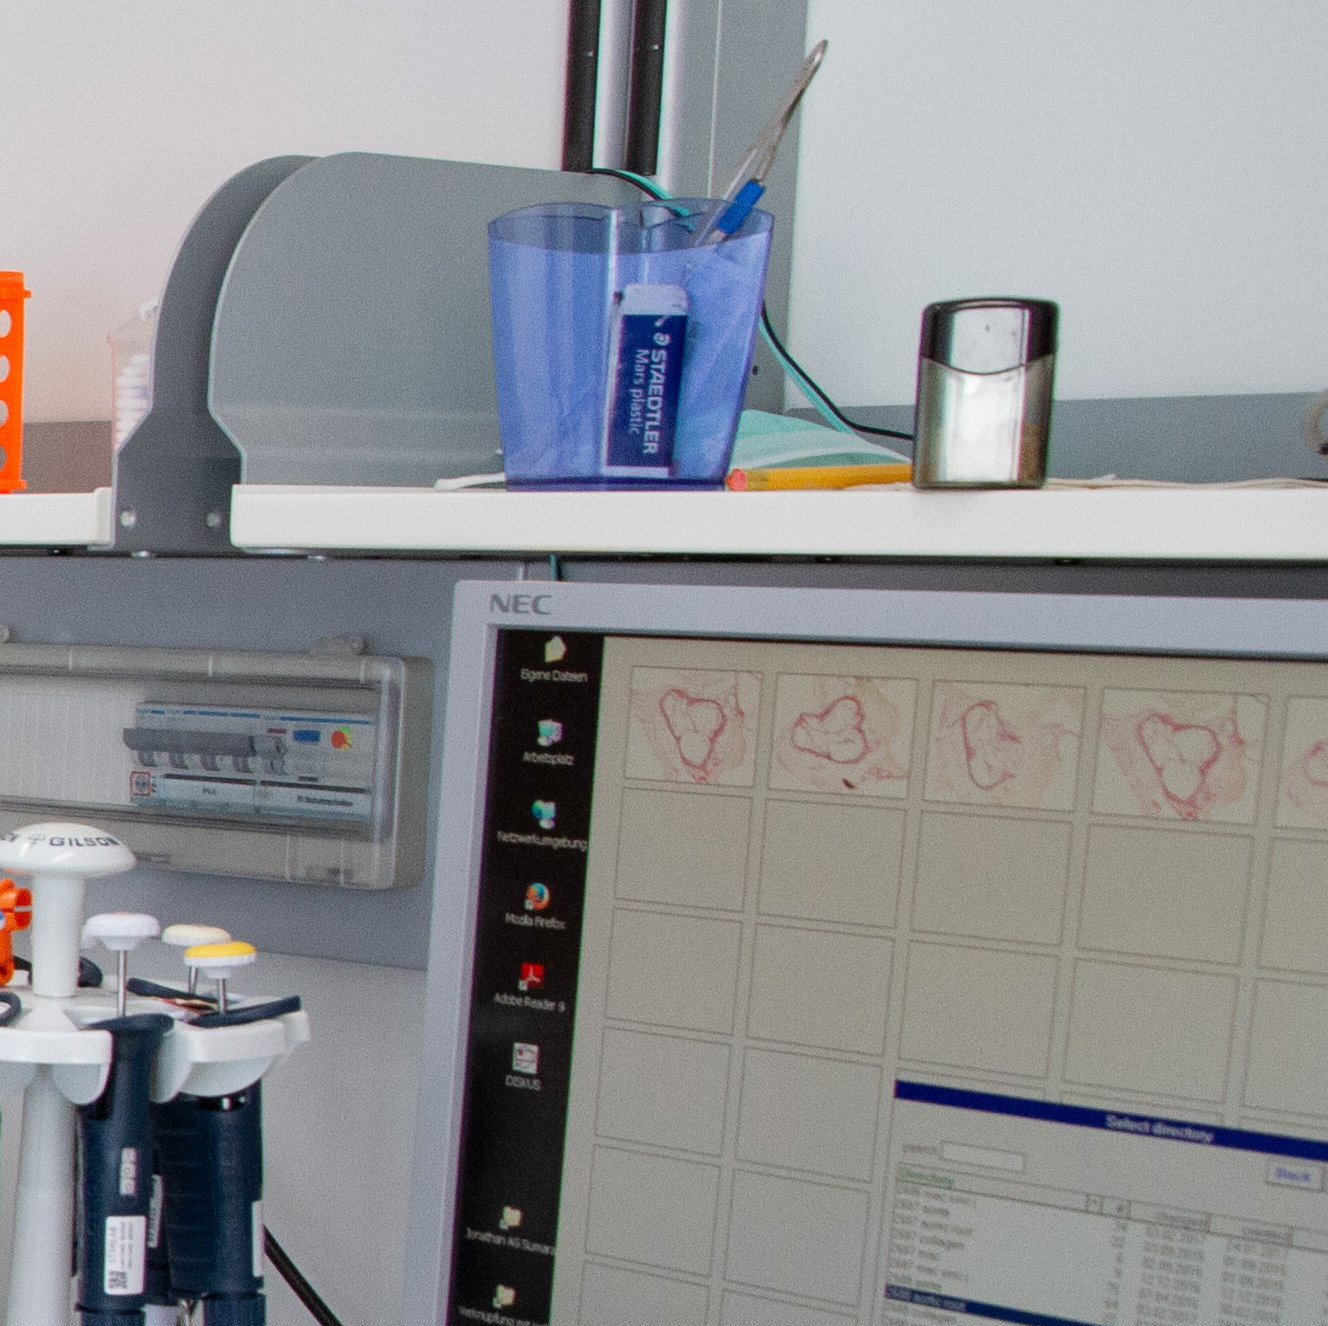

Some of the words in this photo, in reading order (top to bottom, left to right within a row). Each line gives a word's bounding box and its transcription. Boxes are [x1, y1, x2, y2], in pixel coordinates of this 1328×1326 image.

[634, 349, 650, 385] Mars
[628, 388, 645, 435] plastic
[643, 349, 668, 454] STAEDTLER
[489, 594, 552, 615] NEC
[49, 836, 120, 847] GILSON
[1105, 1114, 1150, 1134] Select
[1152, 1122, 1215, 1143] directory
